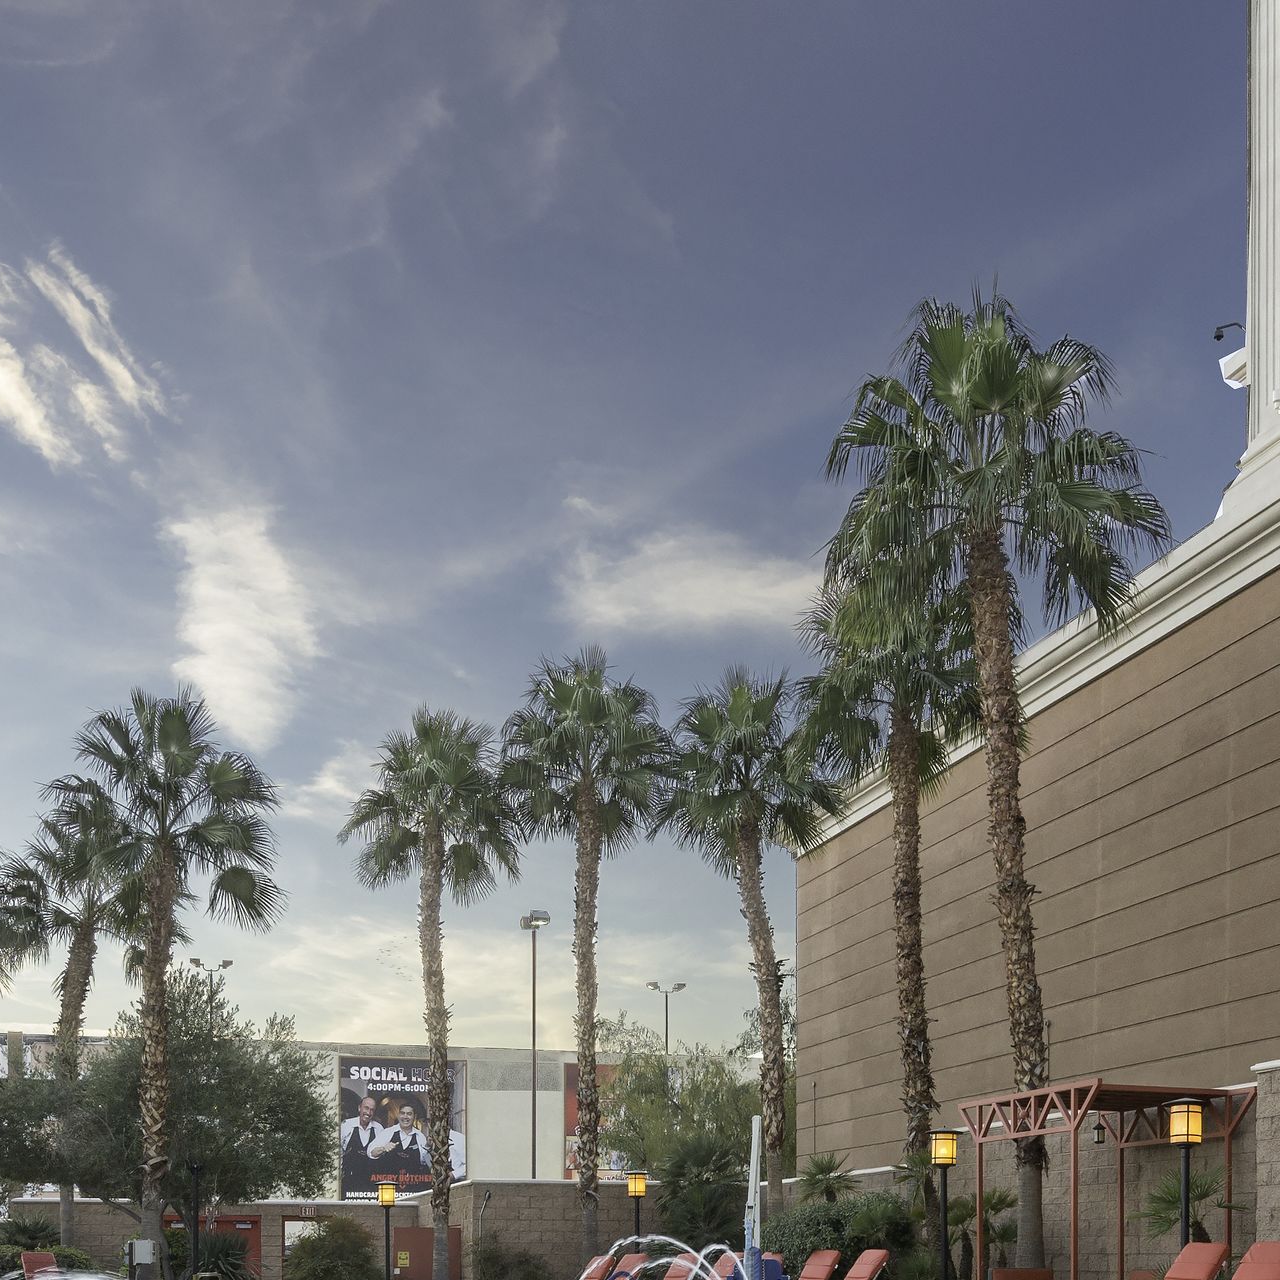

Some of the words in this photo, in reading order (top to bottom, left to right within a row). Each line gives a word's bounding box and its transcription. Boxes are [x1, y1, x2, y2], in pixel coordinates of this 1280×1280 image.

[349, 1066, 408, 1081] SOCIAL
[411, 1067, 456, 1083] HOR
[367, 1083, 429, 1092] 4:00PM-6:00
[301, 1206, 316, 1216] EXIT
